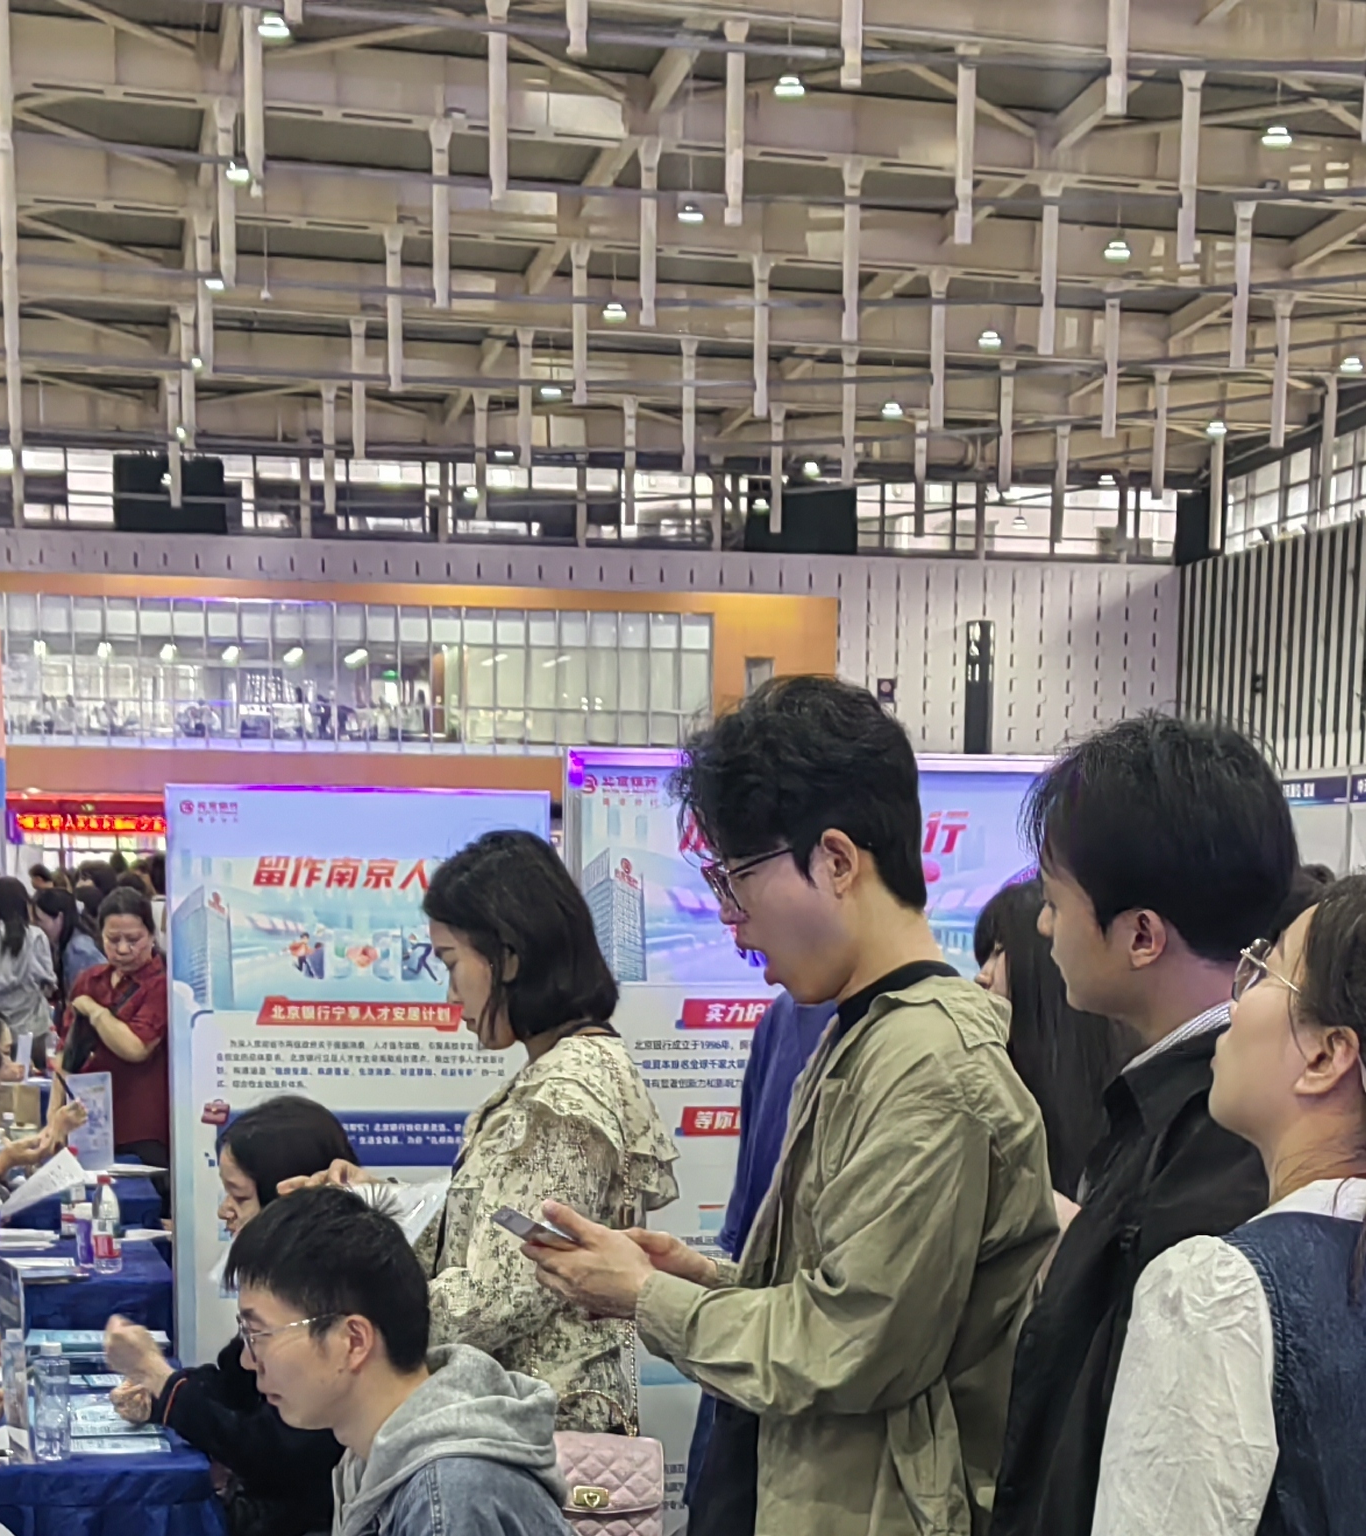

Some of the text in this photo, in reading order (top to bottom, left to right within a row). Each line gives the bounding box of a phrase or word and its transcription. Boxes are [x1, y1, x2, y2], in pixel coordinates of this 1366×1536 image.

[922, 811, 970, 853] 行
[253, 855, 432, 891] 留作南京人
[705, 1003, 771, 1022] 实力护
[695, 1111, 740, 1130] 等你
